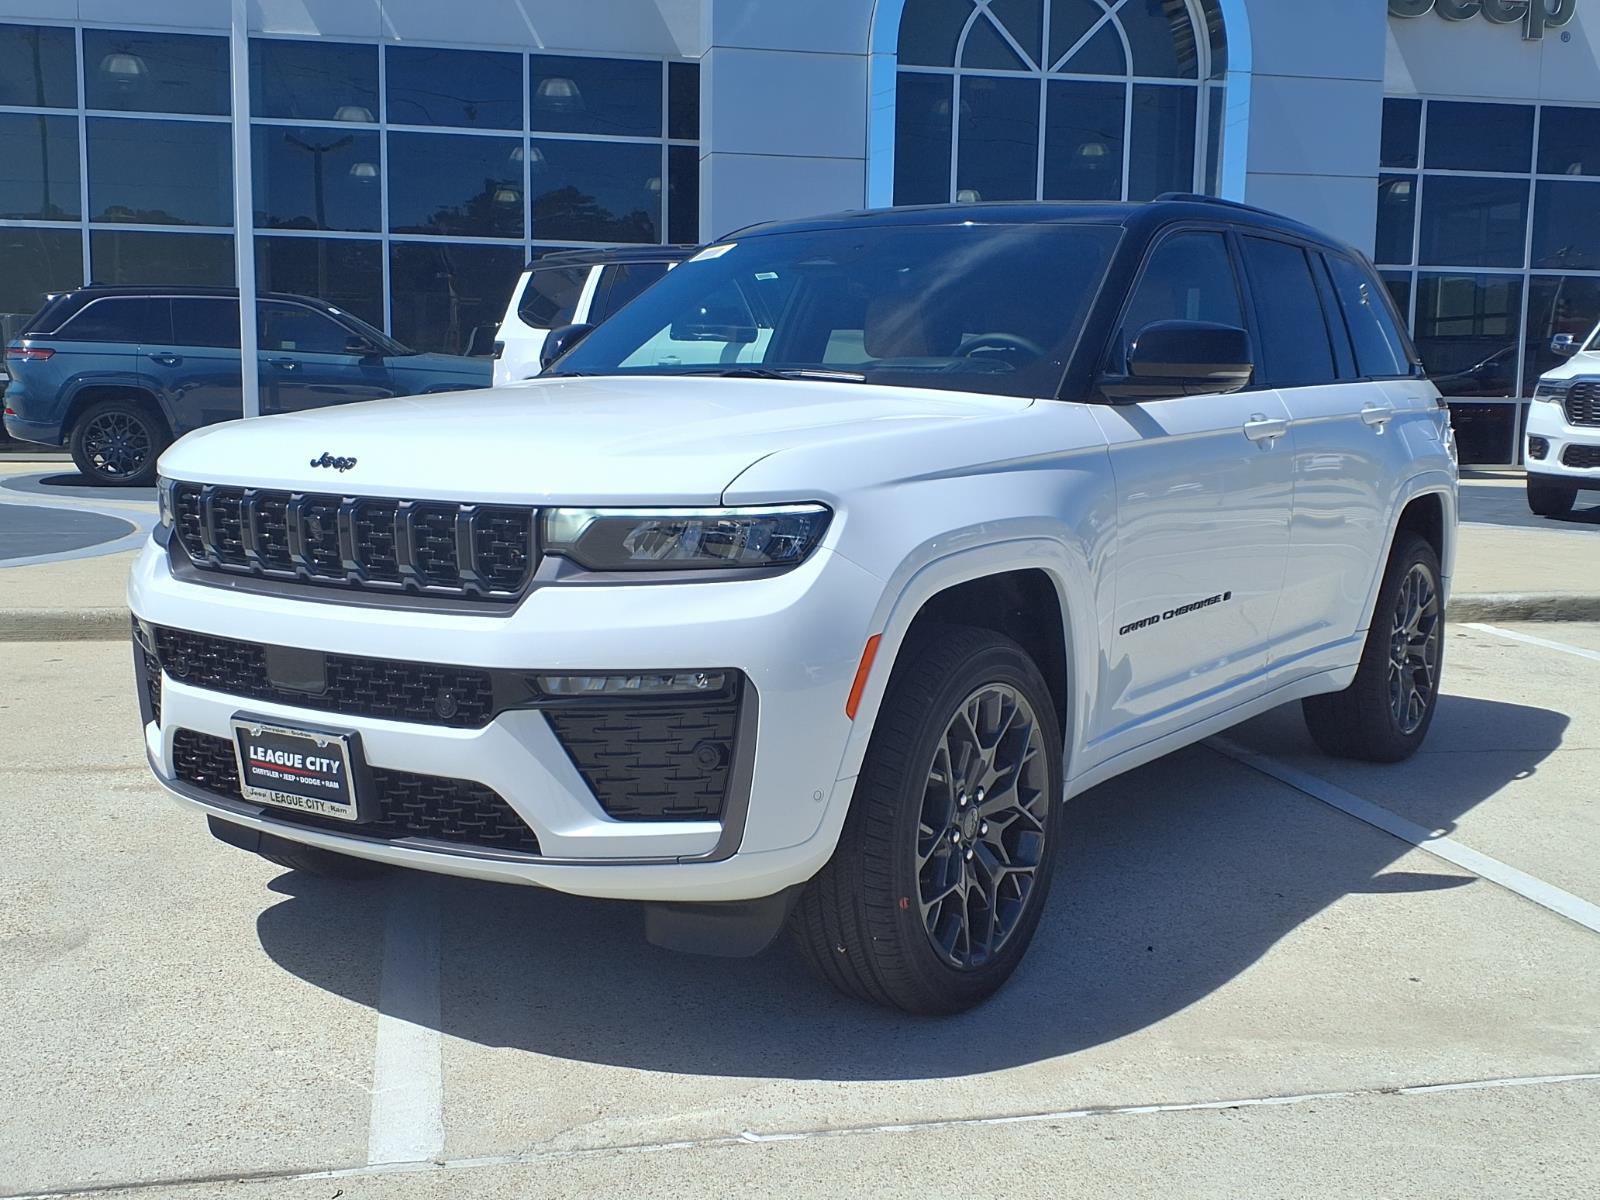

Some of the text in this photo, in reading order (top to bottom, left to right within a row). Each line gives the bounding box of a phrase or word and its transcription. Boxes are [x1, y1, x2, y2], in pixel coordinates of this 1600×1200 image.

[1388, 0, 1577, 40] eep
[310, 452, 357, 473] Jeep
[1119, 594, 1222, 636] GRAND CHEROKEE
[249, 745, 340, 774] LEAGUE CITY
[252, 767, 339, 789] CHRYSLER JEEP DODGE RAM
[270, 791, 303, 807] LEAGUE
[306, 799, 325, 812] CITY
